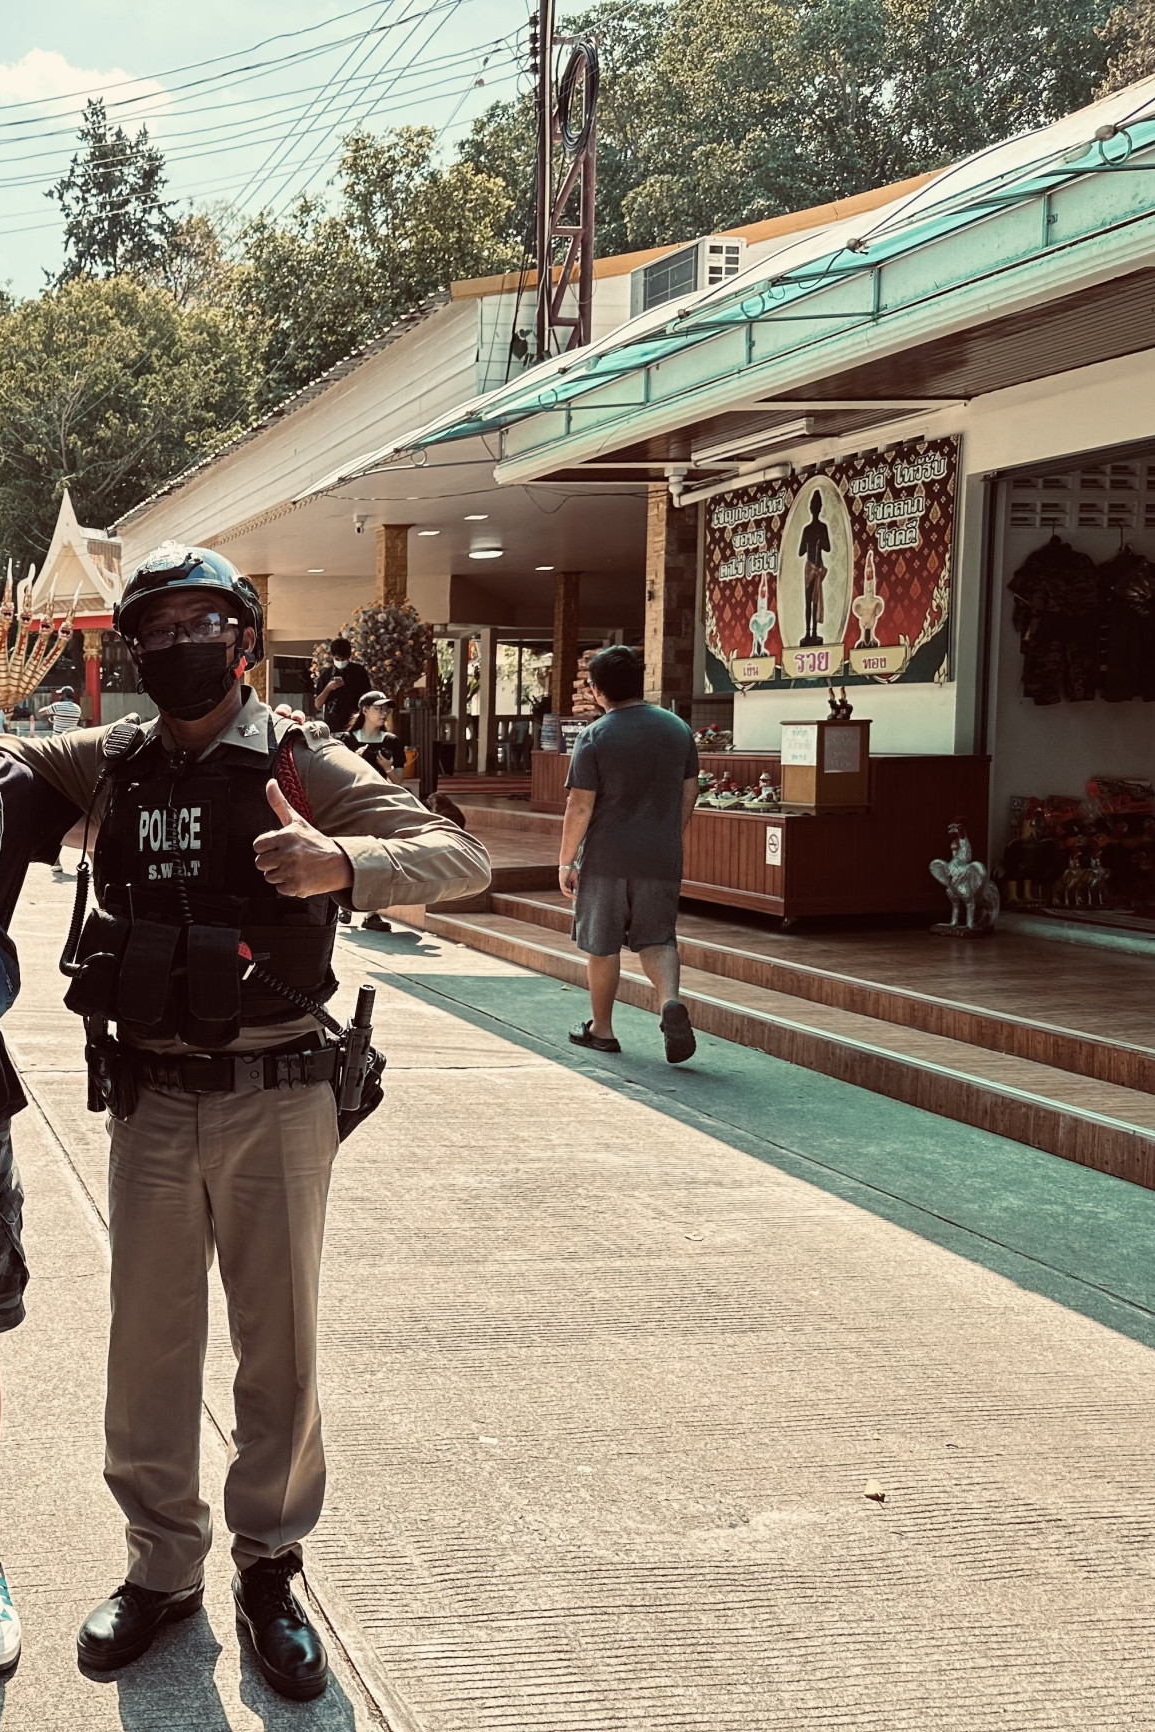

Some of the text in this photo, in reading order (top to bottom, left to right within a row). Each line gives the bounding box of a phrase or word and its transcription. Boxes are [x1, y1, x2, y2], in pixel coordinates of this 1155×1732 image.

[713, 491, 785, 526] เชิญกราบไหว้
[865, 496, 924, 522] โชคลาภ
[733, 530, 765, 548] ขอพร
[877, 519, 917, 549] โชคดี
[795, 652, 830, 672] รวย
[863, 658, 886, 669] ทอง
[148, 860, 201, 880] S.W.T
